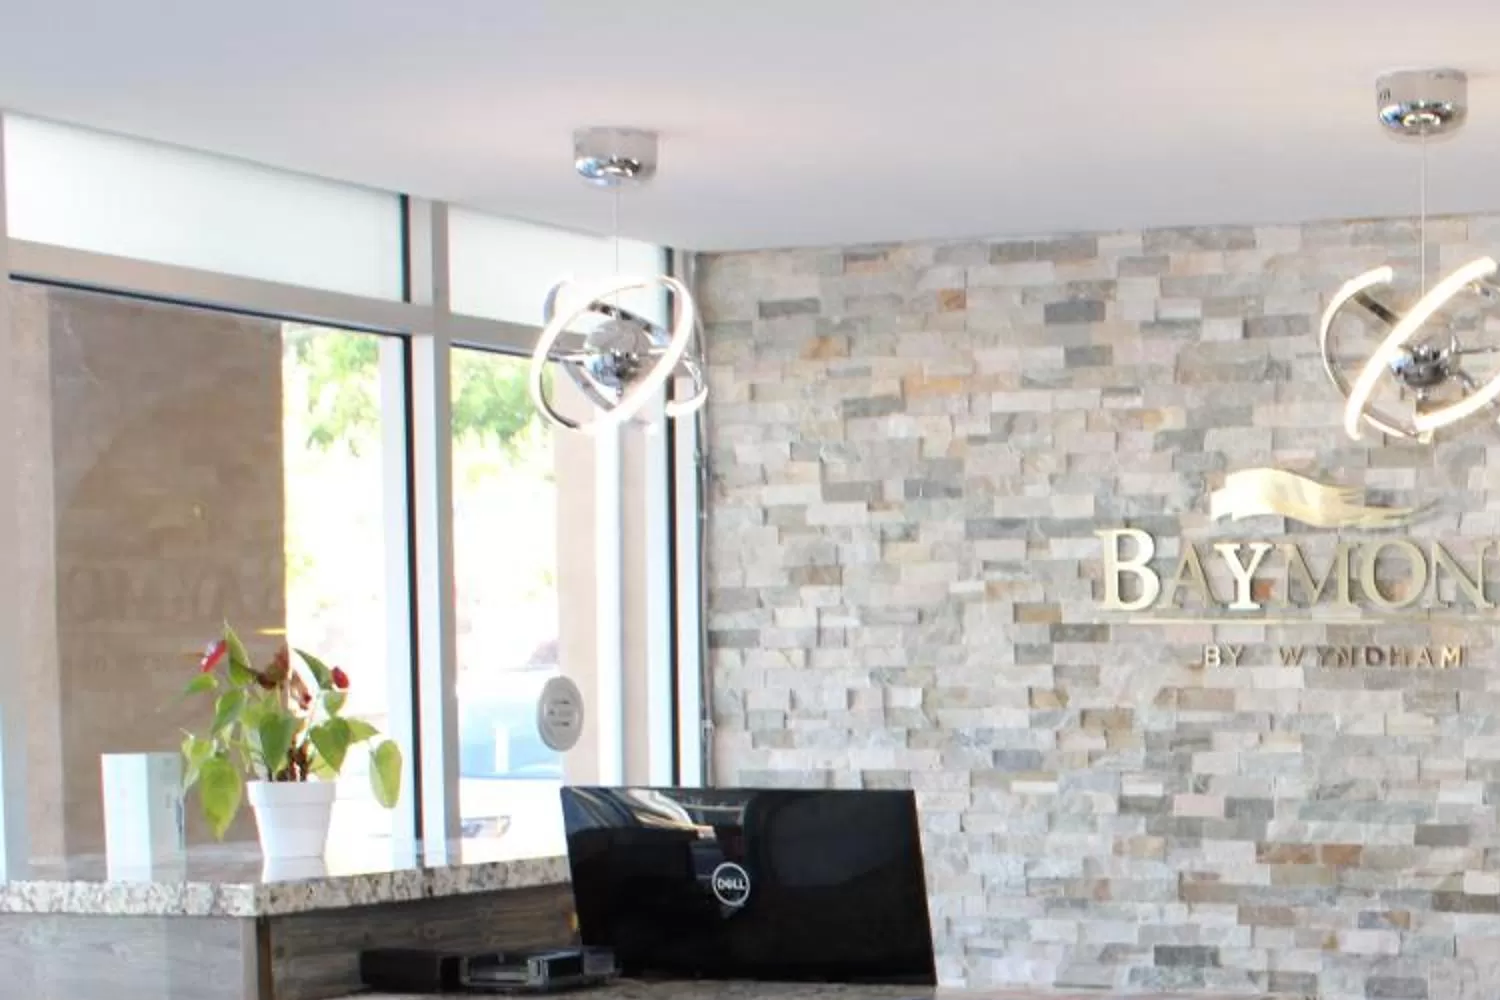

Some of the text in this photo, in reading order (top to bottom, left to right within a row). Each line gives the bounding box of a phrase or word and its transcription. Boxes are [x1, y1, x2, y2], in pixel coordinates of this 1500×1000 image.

[1201, 643, 1467, 669] BY WYNDHAM
[717, 877, 746, 891] DELL
